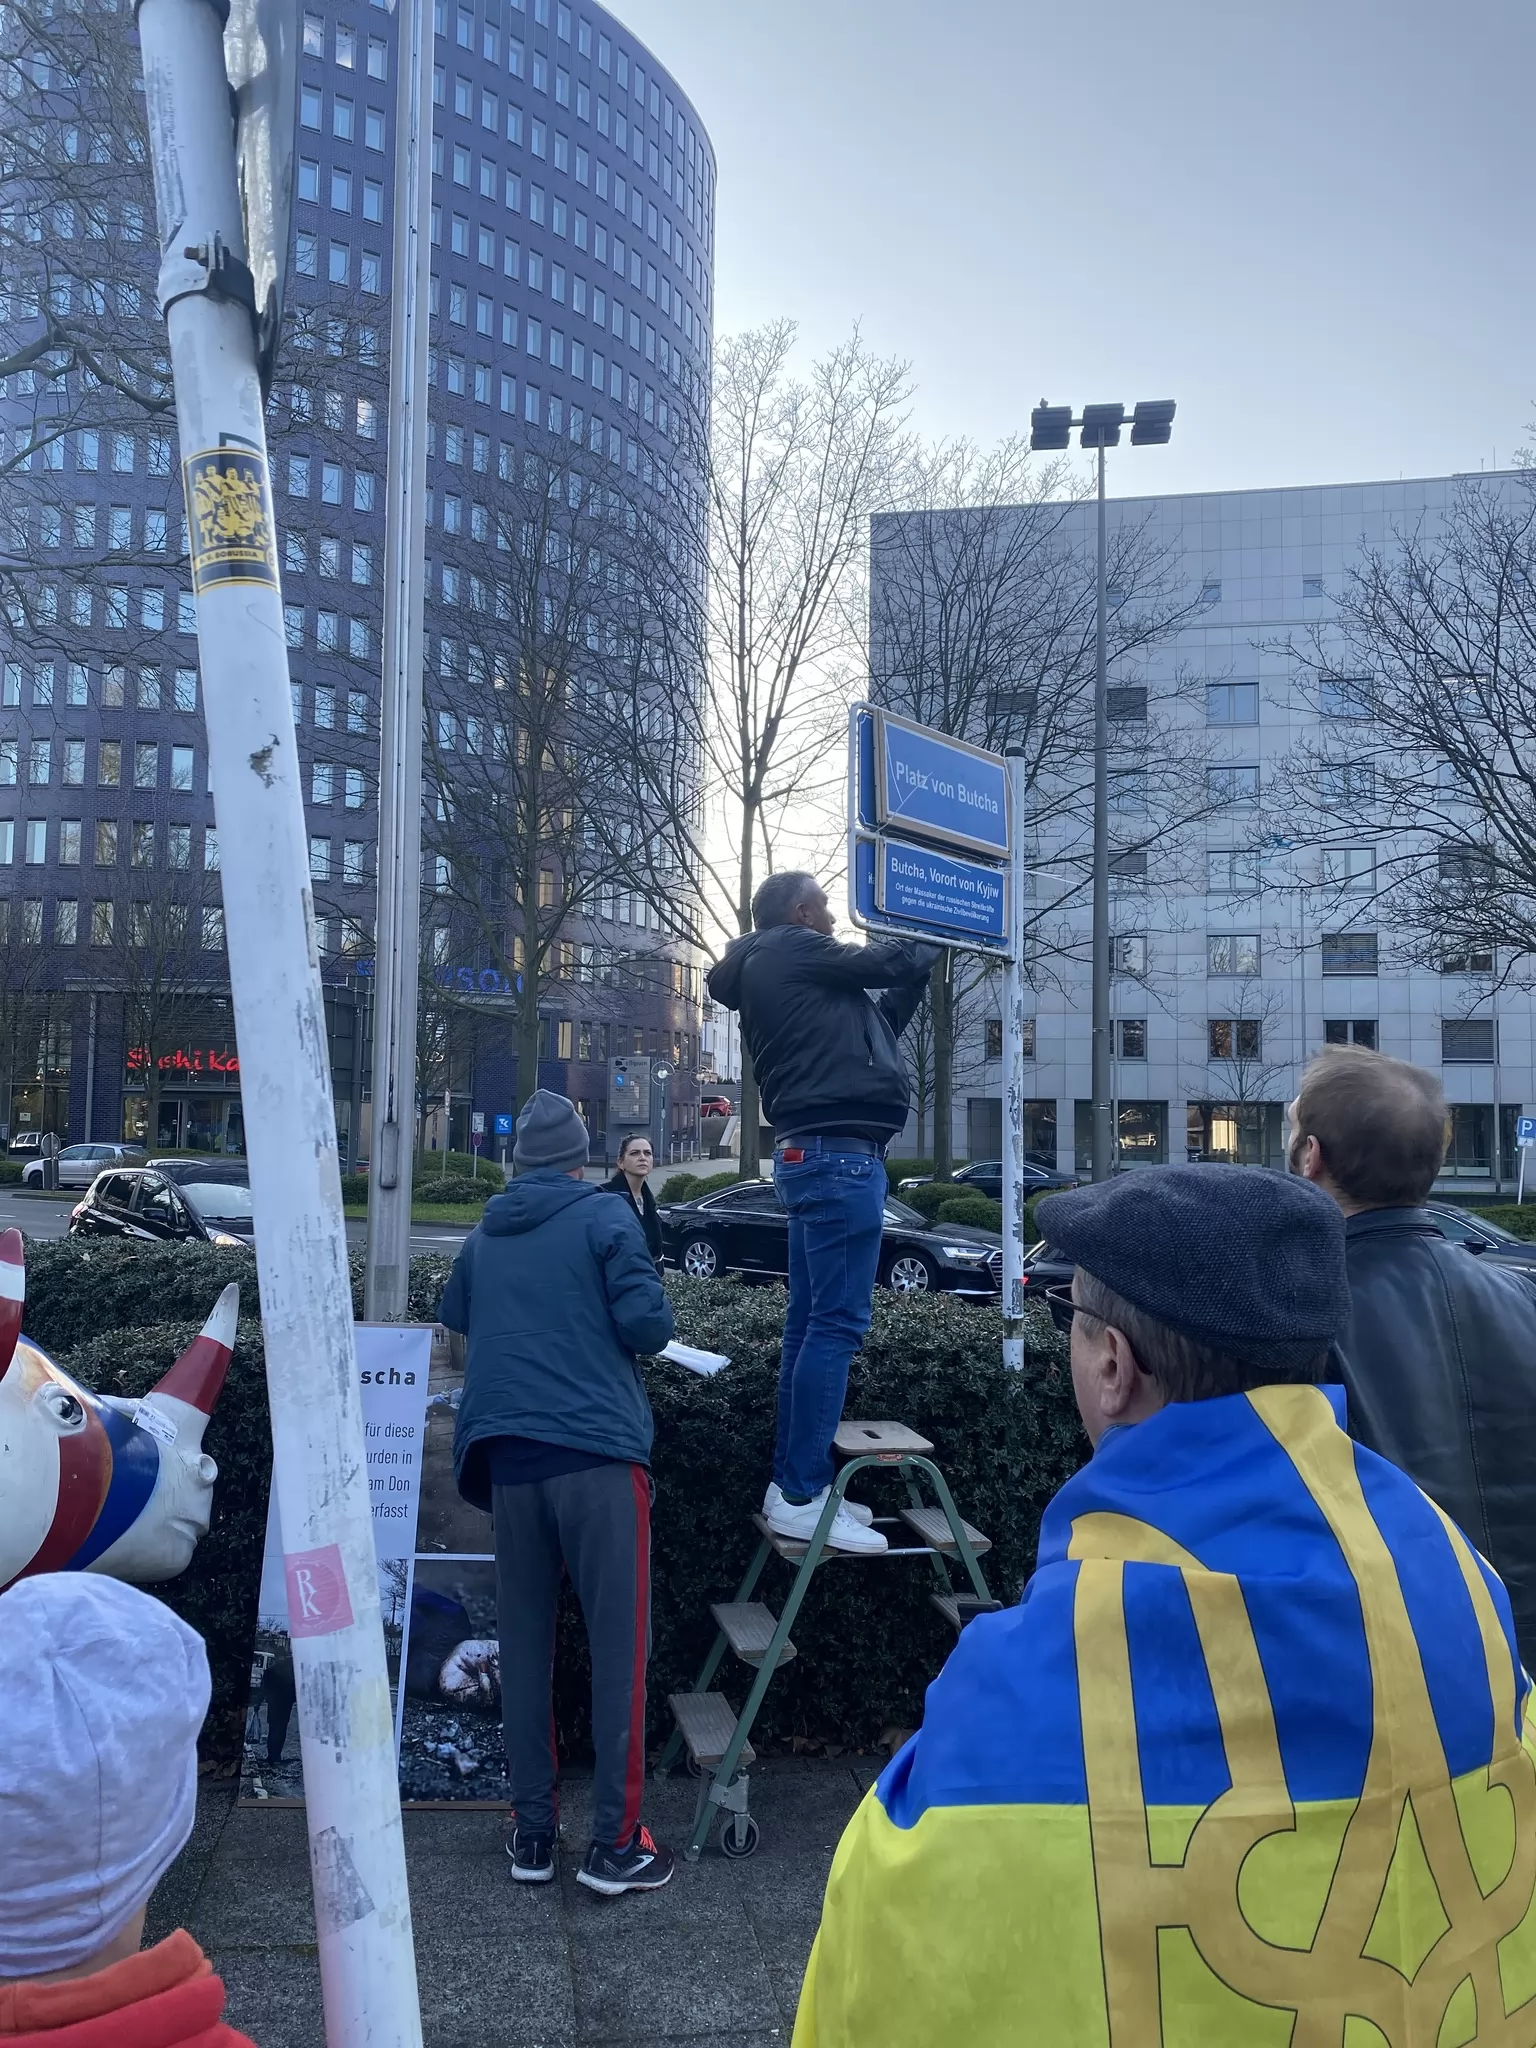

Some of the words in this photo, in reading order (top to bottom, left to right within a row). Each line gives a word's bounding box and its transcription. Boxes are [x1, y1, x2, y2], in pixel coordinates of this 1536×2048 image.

[895, 760, 929, 791] Platz
[931, 778, 955, 799] von
[957, 783, 999, 815] Butcha
[891, 857, 927, 883] Butcha,
[929, 867, 957, 888] Vorort
[958, 878, 975, 892] von
[976, 880, 1000, 899] Kyjiw
[895, 882, 904, 892] Ort
[904, 885, 913, 894] der
[913, 886, 937, 899] Massaker
[937, 893, 946, 901] der
[945, 895, 971, 908] russischen
[901, 896, 917, 905] gegen
[917, 898, 925, 907] die
[925, 900, 954, 913] ukrainische
[499, 1118, 509, 1128] TK
[1521, 1120, 1533, 1136] P
[360, 1367, 416, 1386] scha
[365, 1422, 381, 1438] für
[384, 1422, 415, 1438] diese
[366, 1449, 398, 1464] urden
[402, 1449, 412, 1465] in
[388, 1475, 410, 1491] Don
